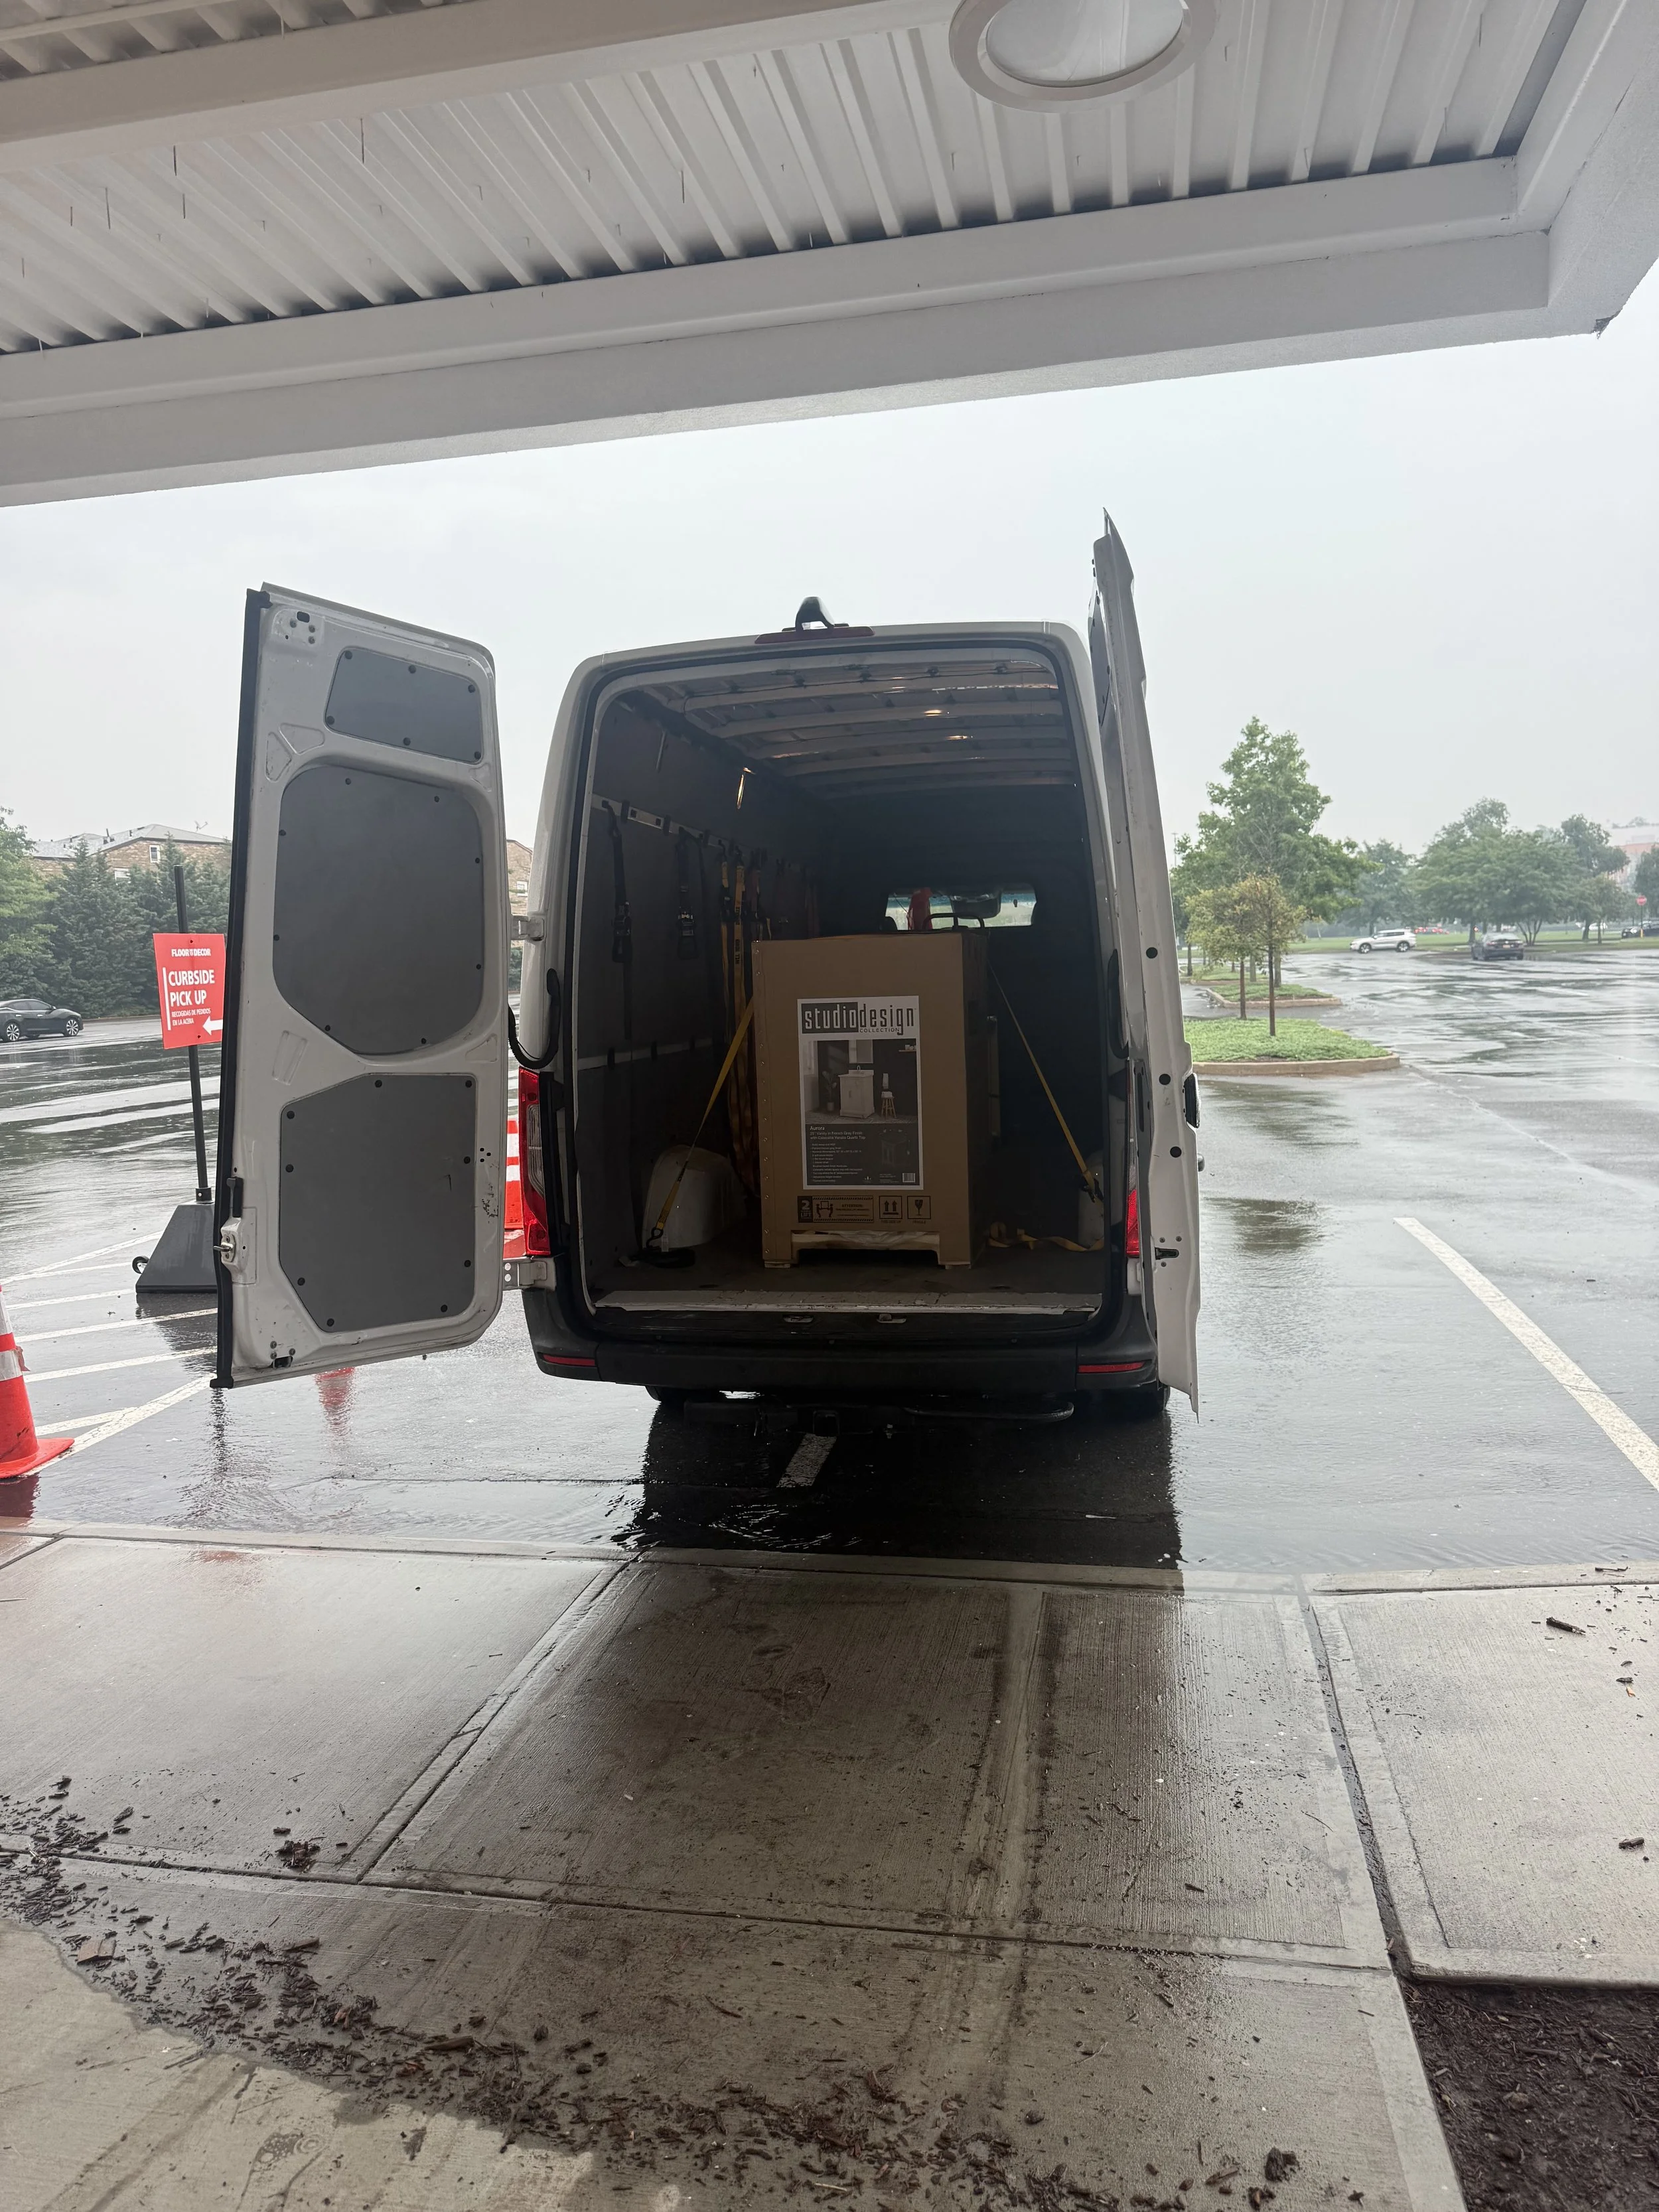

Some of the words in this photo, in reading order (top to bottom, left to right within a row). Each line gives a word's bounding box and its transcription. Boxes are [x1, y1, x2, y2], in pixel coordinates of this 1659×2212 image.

[168, 970, 215, 986] CURBSIDE
[170, 991, 192, 1007] PICK
[194, 990, 207, 1005] UP
[801, 1200, 810, 1210] 2
